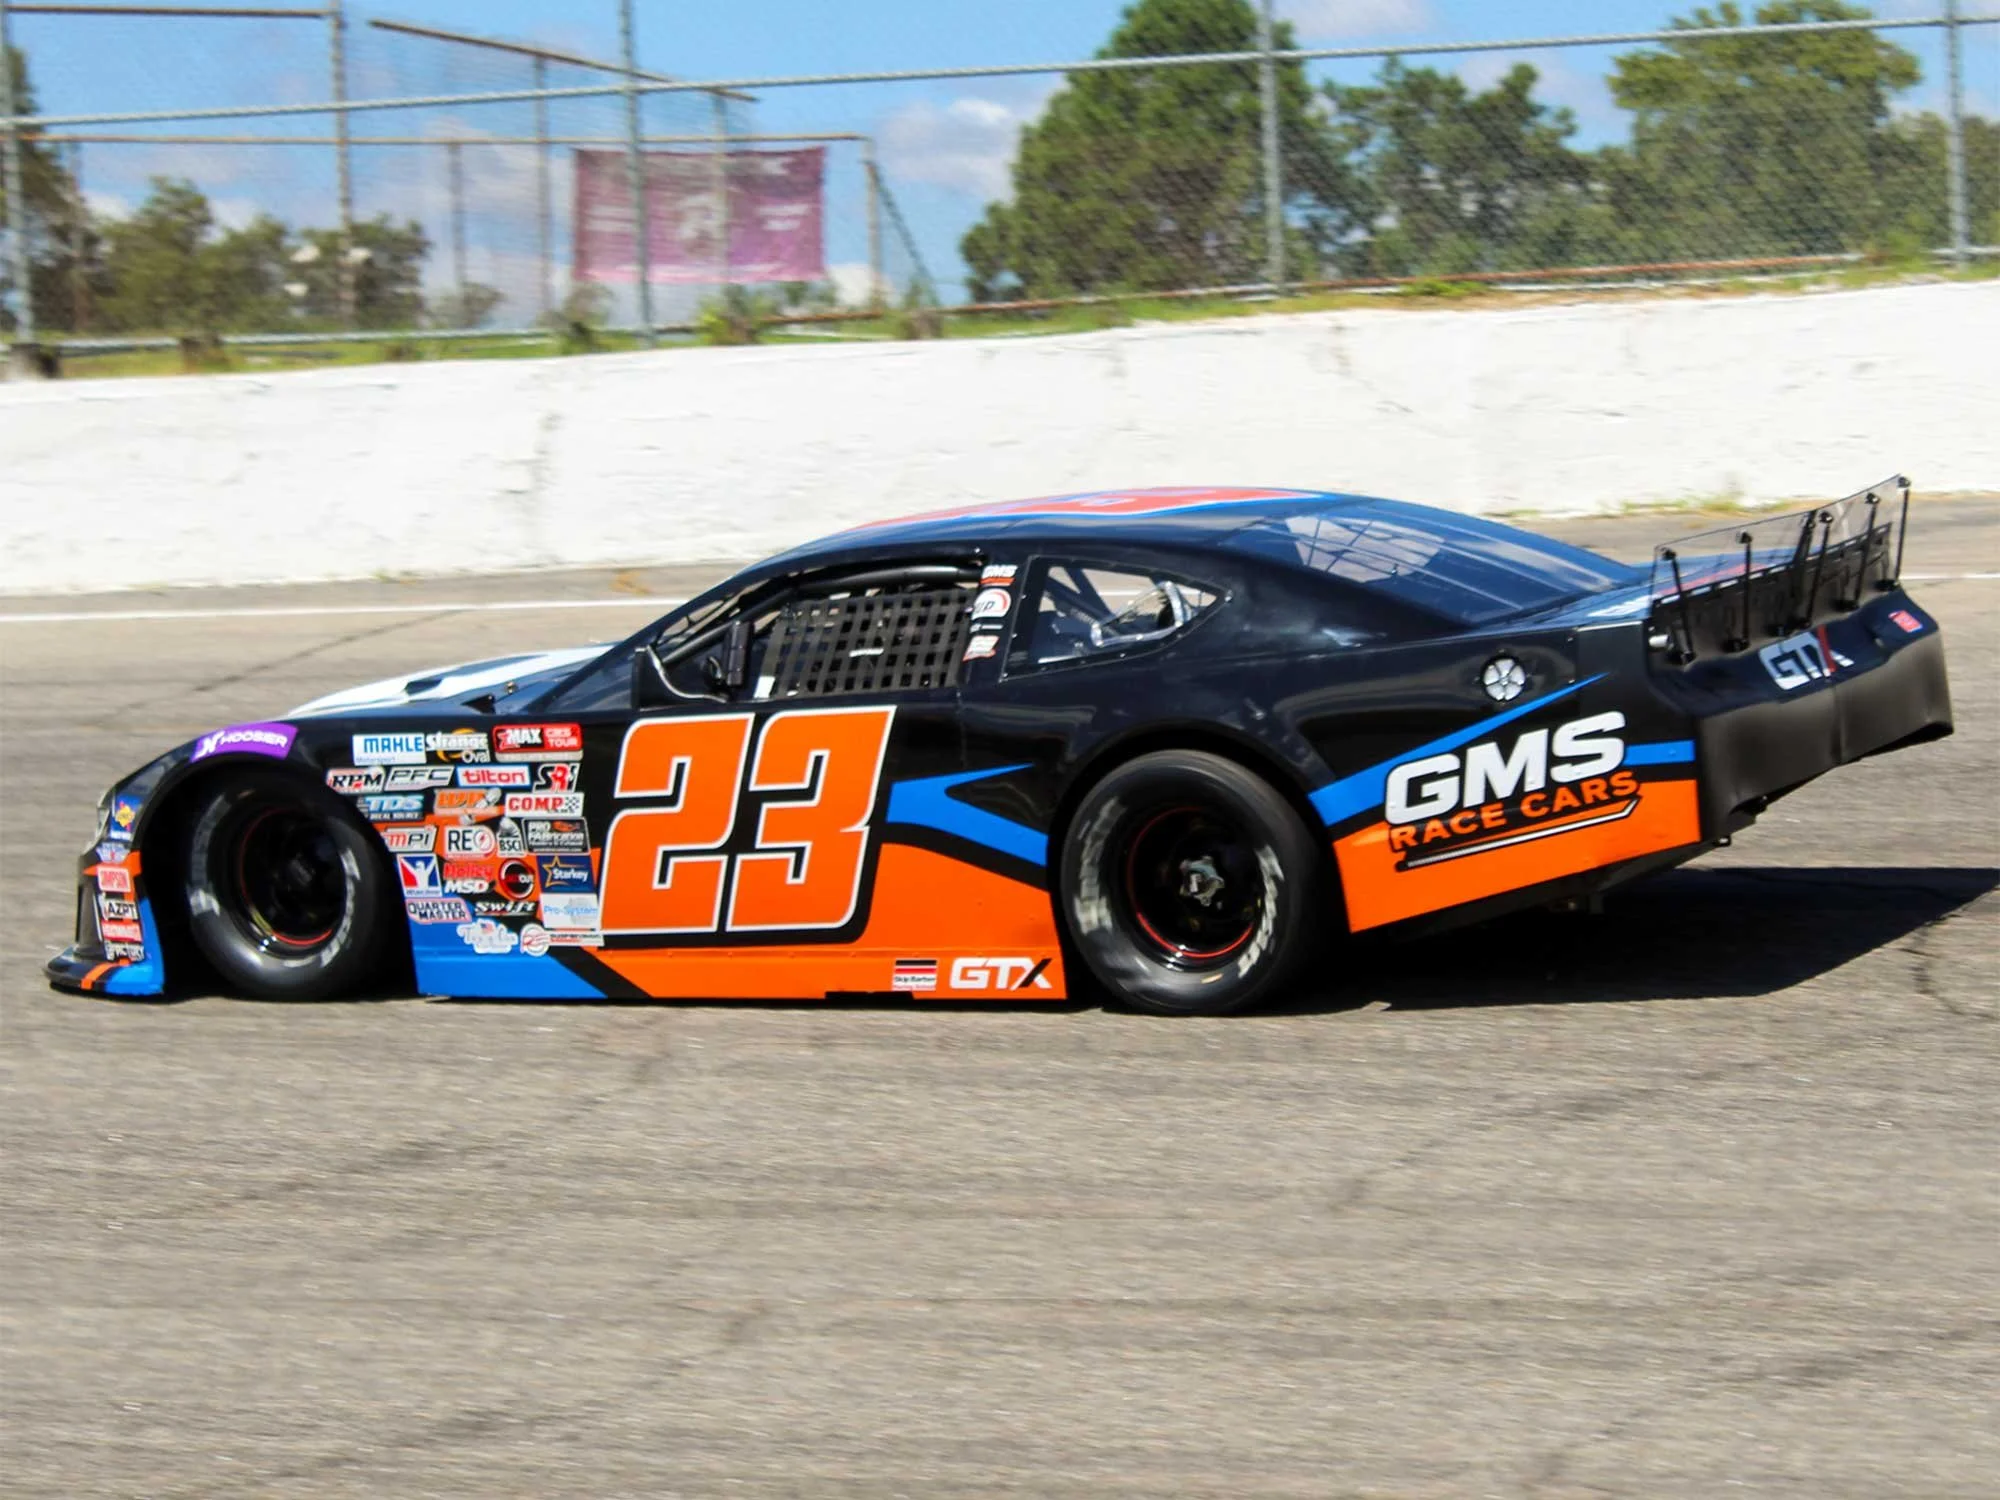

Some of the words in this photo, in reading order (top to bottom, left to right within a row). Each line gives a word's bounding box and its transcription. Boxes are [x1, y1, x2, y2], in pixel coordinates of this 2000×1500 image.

[364, 737, 424, 753] MAHLE
[548, 738, 578, 748] TOUR
[461, 750, 490, 763] Oval
[390, 769, 452, 781] PFC
[1385, 711, 1625, 825] GMS
[332, 774, 382, 788] RPM
[463, 770, 526, 784] tilton
[508, 797, 564, 811] COMP
[1390, 803, 1507, 849] RACE
[1520, 771, 1640, 817] CARS
[600, 704, 897, 934] 23
[553, 867, 589, 882] Starkey
[444, 880, 489, 894] MSD
[408, 902, 462, 914] QUARTER
[420, 911, 466, 919] MASTER
[949, 957, 1053, 991] GTX
